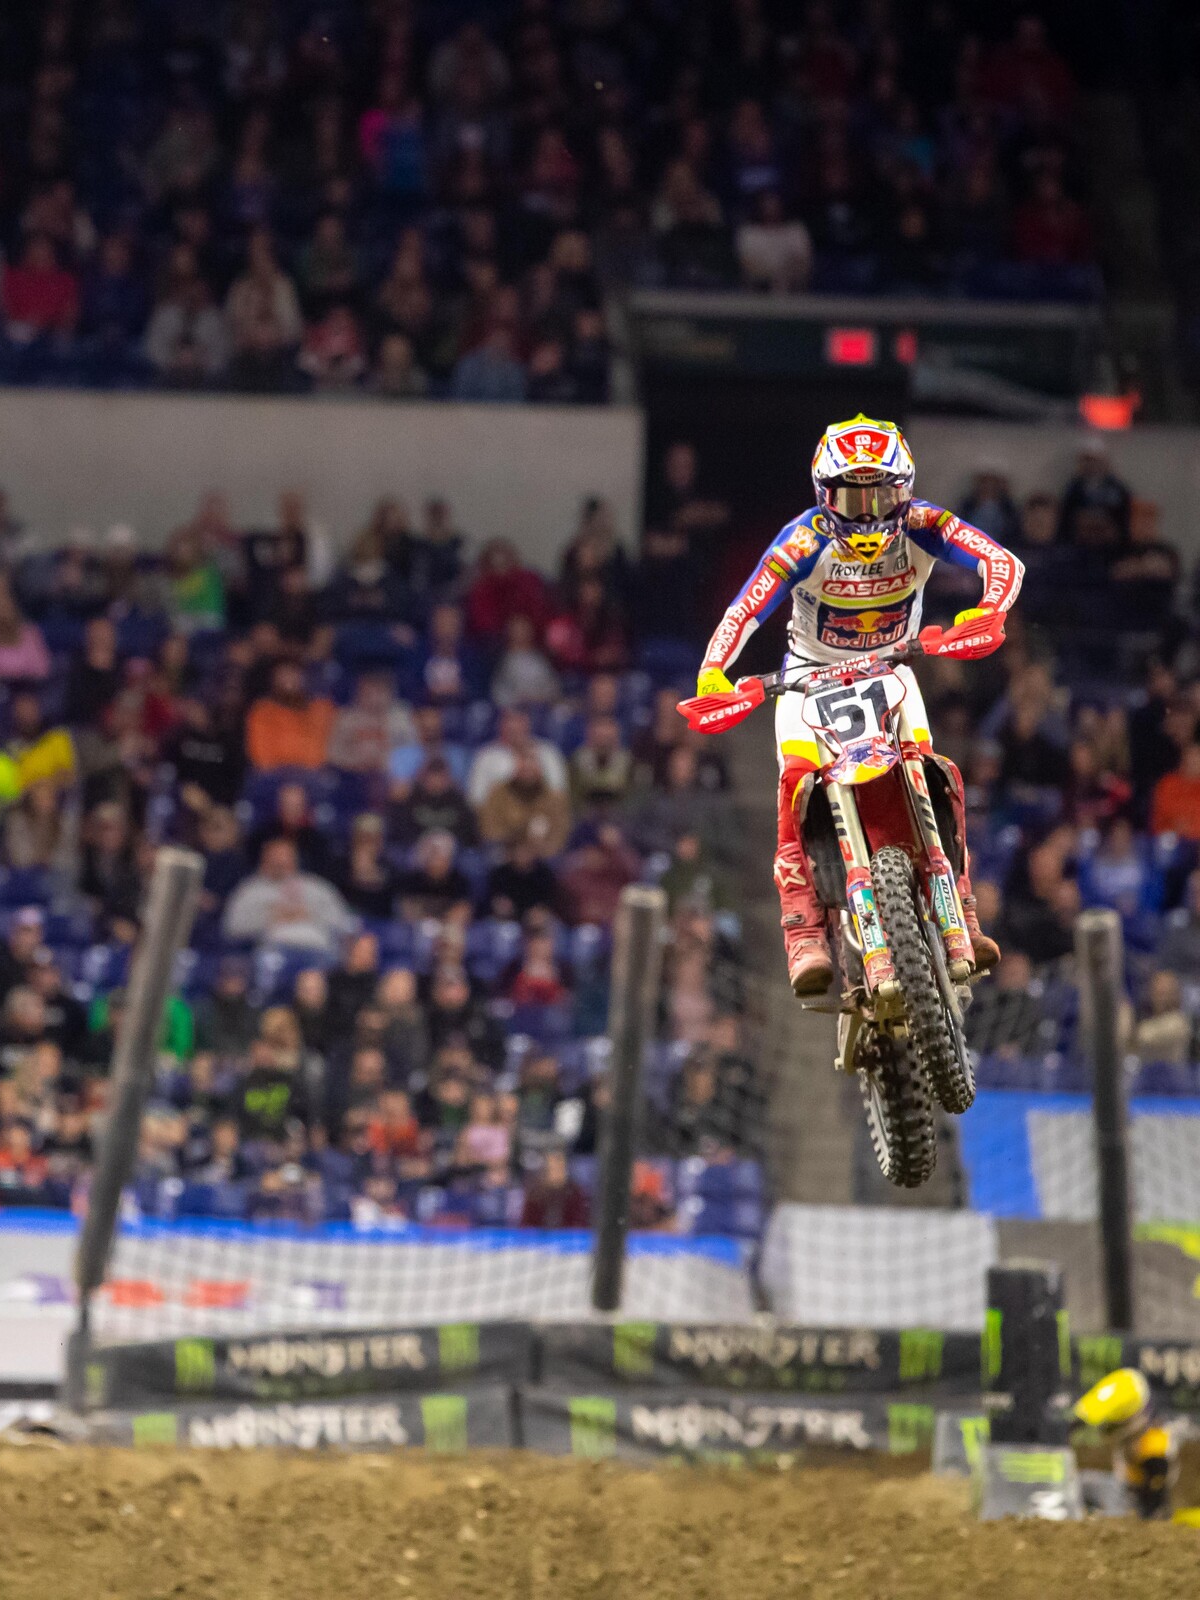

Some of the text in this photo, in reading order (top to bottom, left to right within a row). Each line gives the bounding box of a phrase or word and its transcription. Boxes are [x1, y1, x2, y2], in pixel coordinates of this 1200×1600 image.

[830, 561, 884, 577] TROY LEE
[991, 561, 1010, 580] LEE
[824, 571, 916, 597] GASGAS
[983, 579, 1006, 604] TROY
[708, 570, 776, 663] TROY LEE DESIGNS
[821, 620, 907, 648] Red Bull
[938, 635, 993, 653] ACERBIS
[699, 701, 752, 725] ACERBIS
[815, 680, 890, 744] 51
[941, 879, 957, 924] DUNLOP
[857, 903, 873, 949] DULOP
